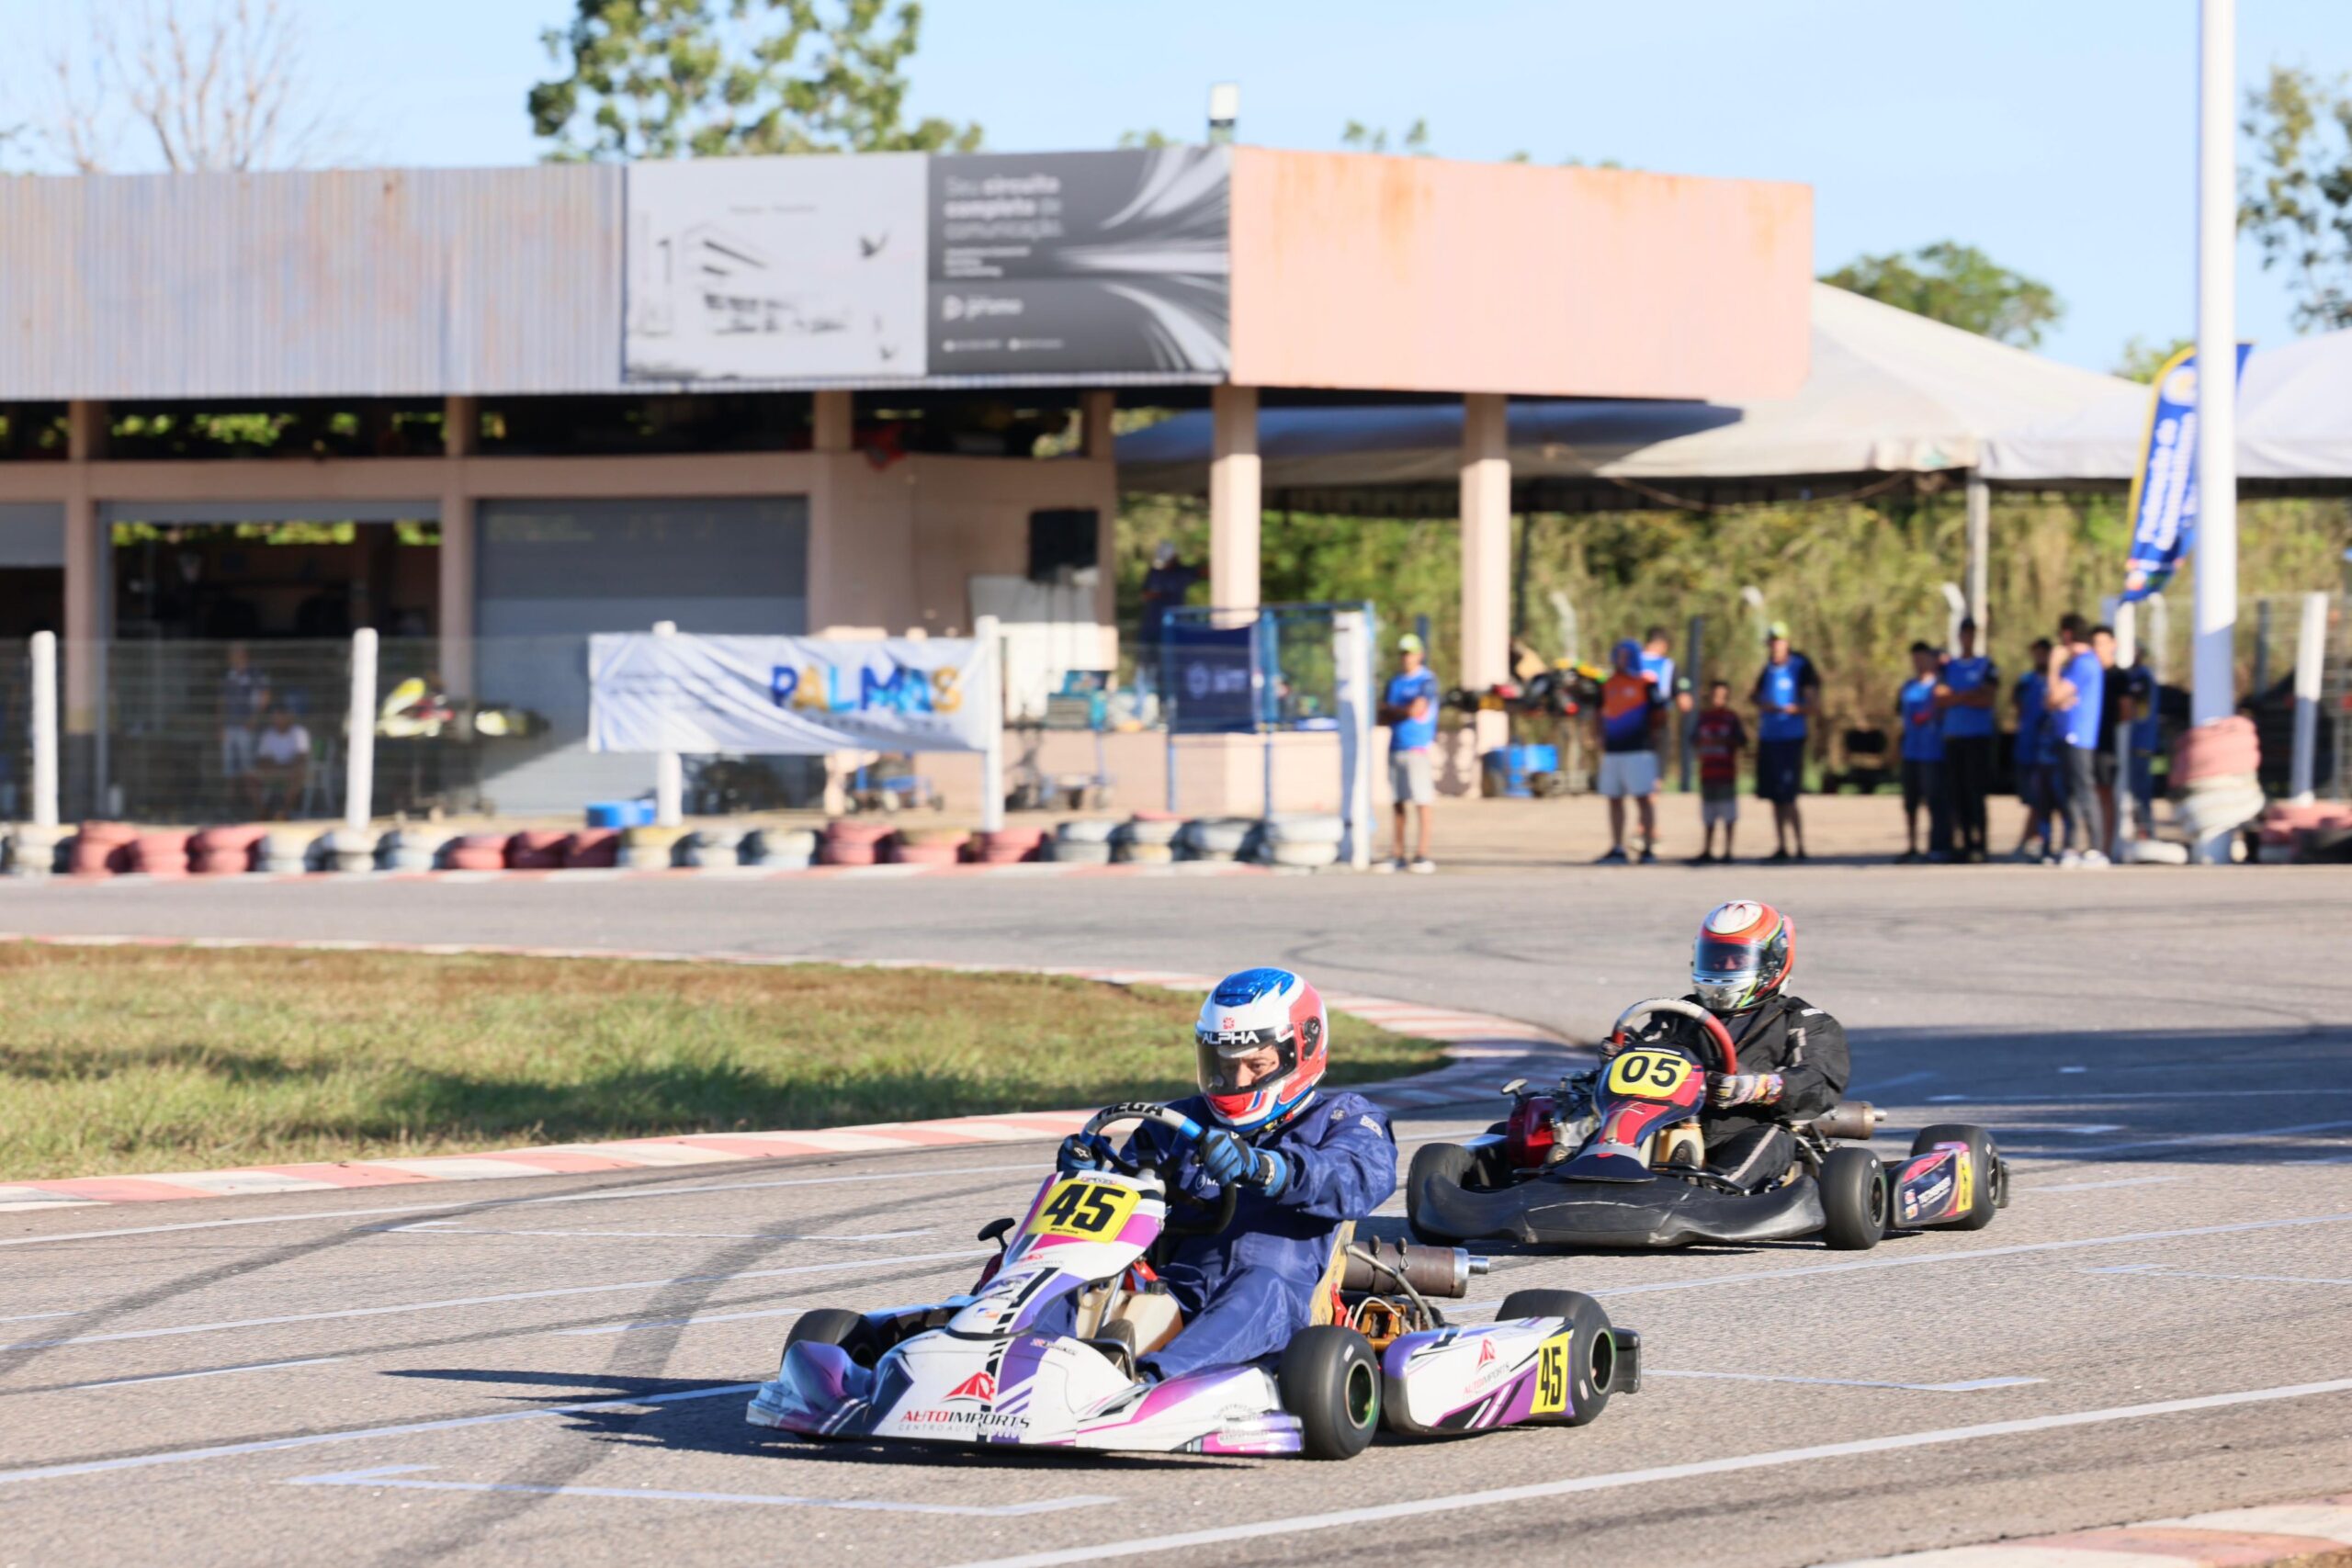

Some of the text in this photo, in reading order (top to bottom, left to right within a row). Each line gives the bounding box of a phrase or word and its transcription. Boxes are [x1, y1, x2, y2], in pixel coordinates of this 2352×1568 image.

[773, 665, 963, 714] PALMAS
[1202, 1030, 1260, 1045] ALPHA
[1621, 1055, 1681, 1088] 05
[1043, 1183, 1126, 1233] 45
[1538, 1346, 1563, 1407] 45
[899, 1410, 1033, 1429] AUTOIMPORTS
